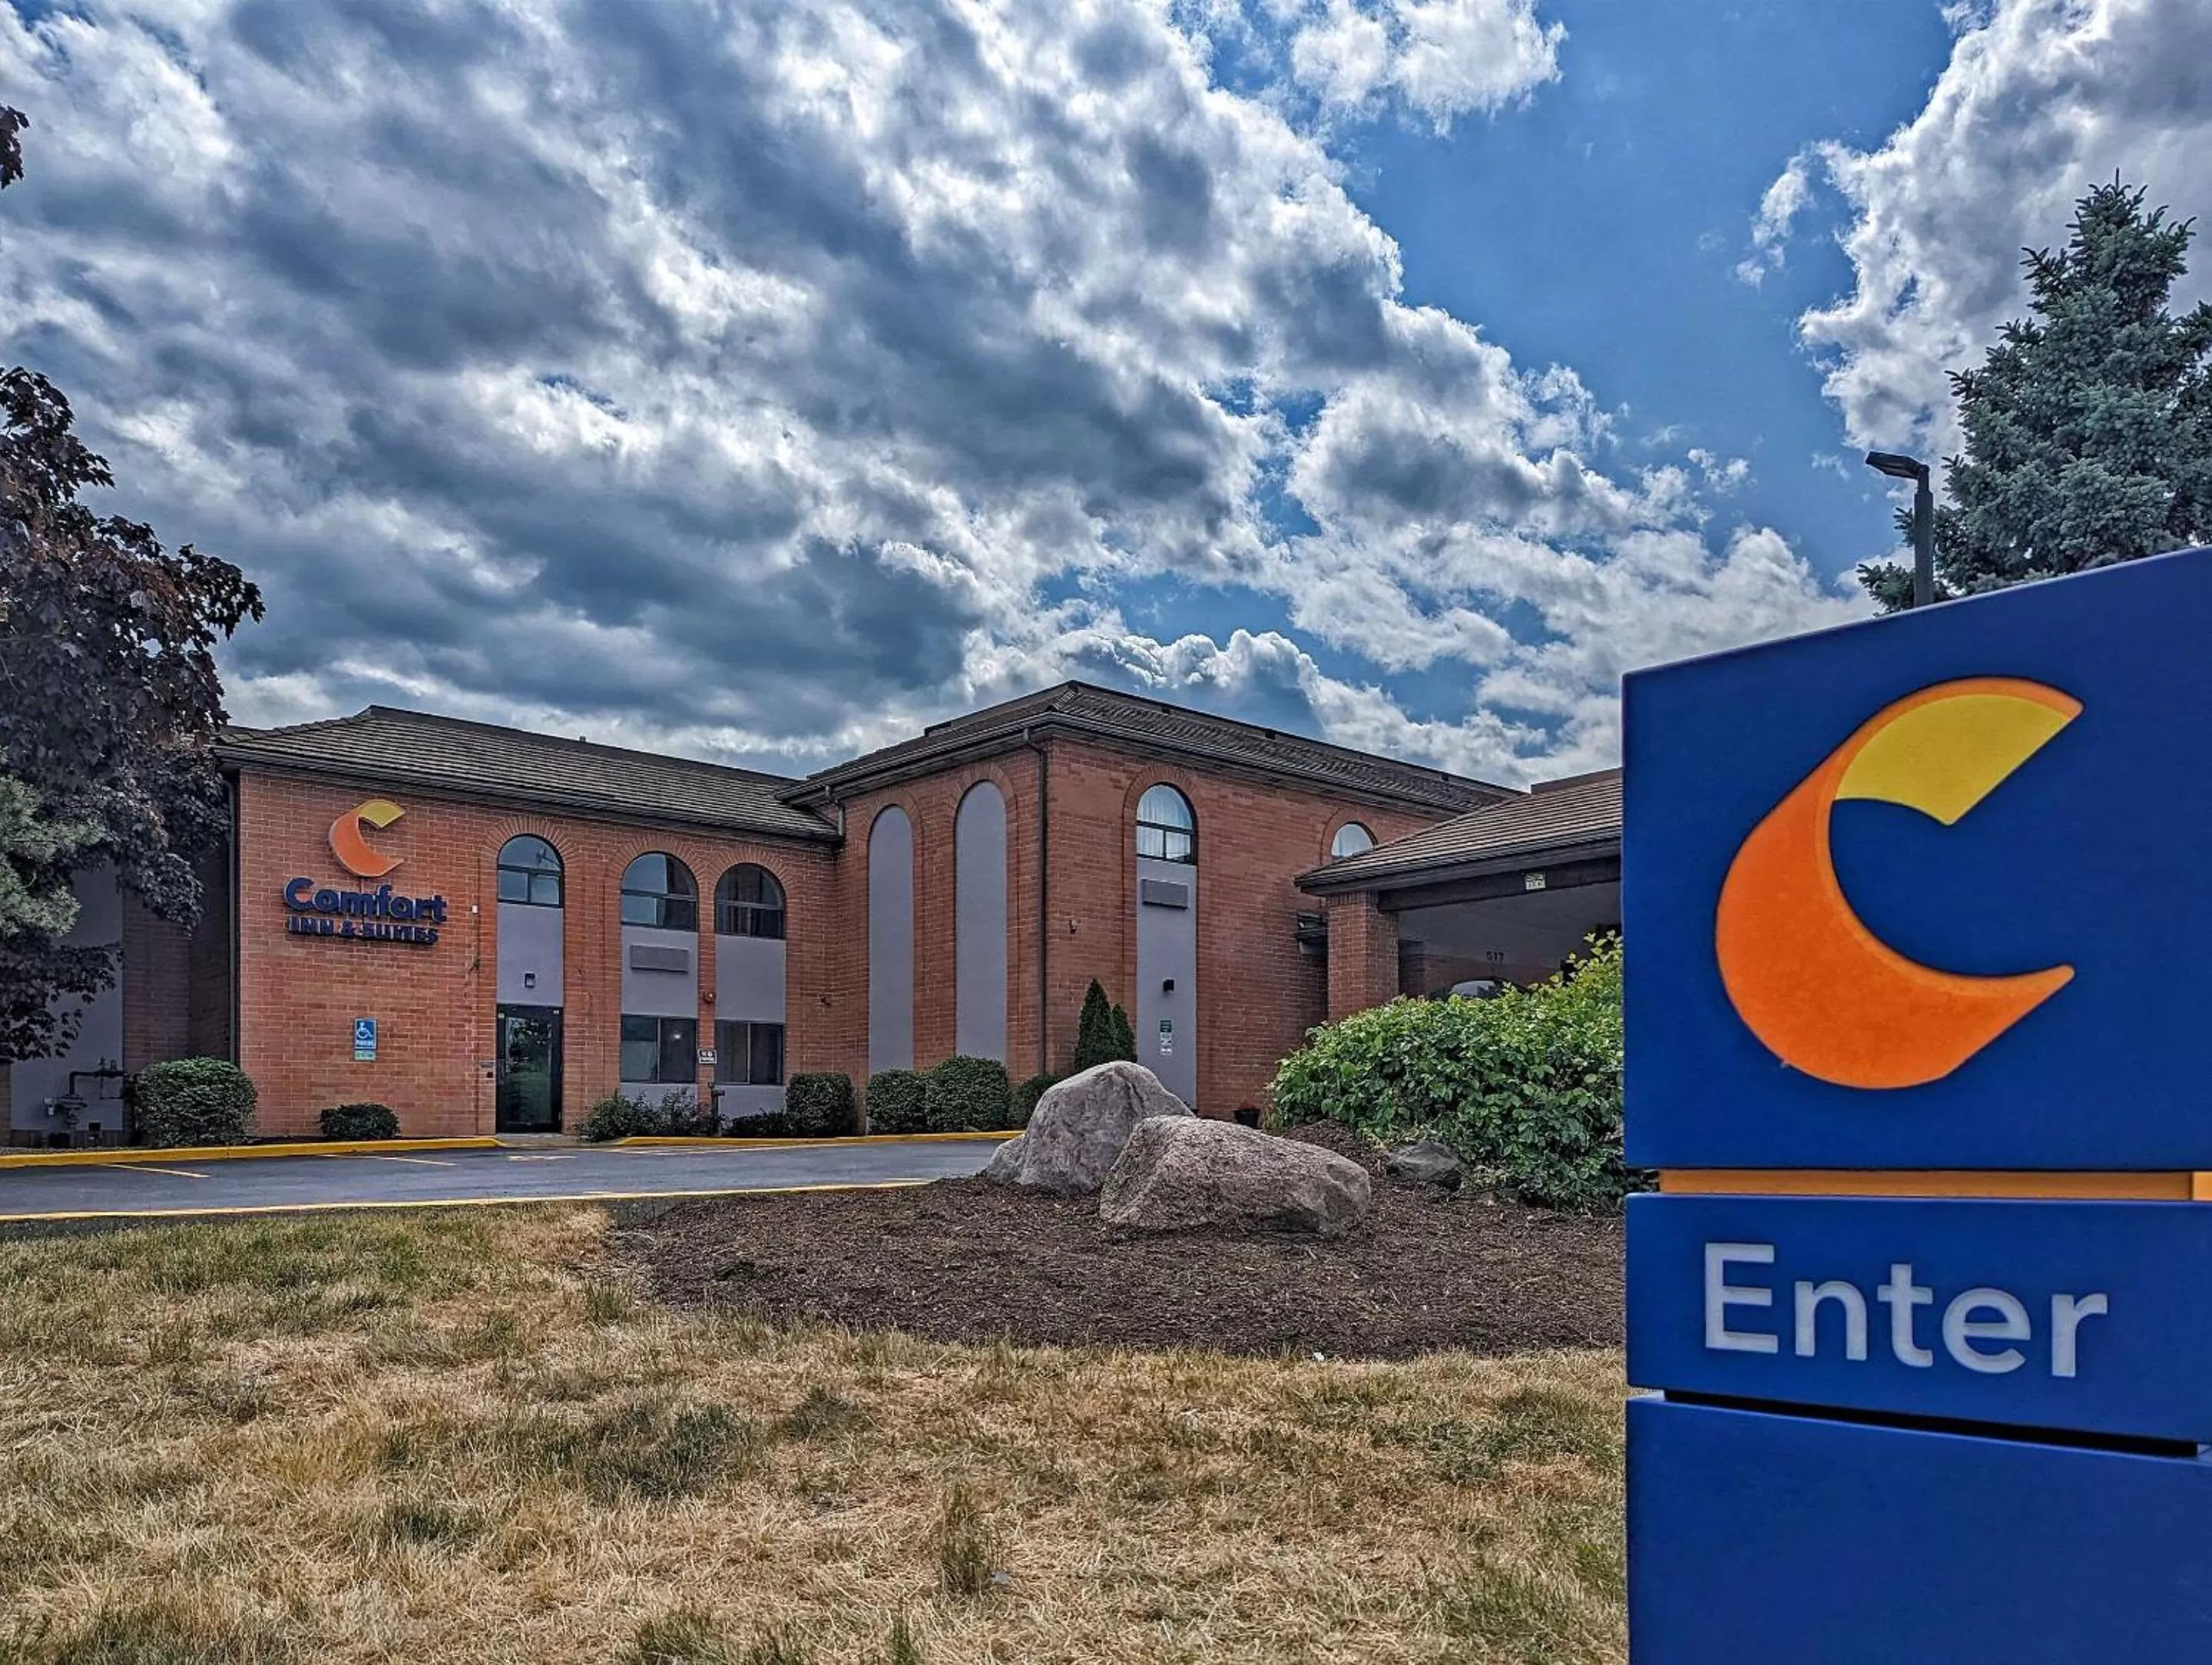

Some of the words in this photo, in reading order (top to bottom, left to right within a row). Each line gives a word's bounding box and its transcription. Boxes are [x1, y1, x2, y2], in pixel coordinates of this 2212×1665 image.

[284, 877, 448, 923] Comfort
[288, 915, 335, 935] INN
[339, 920, 362, 938] &
[362, 923, 439, 945] SUITES
[1486, 951, 1505, 965] 517
[1704, 1242, 2108, 1379] Enter
